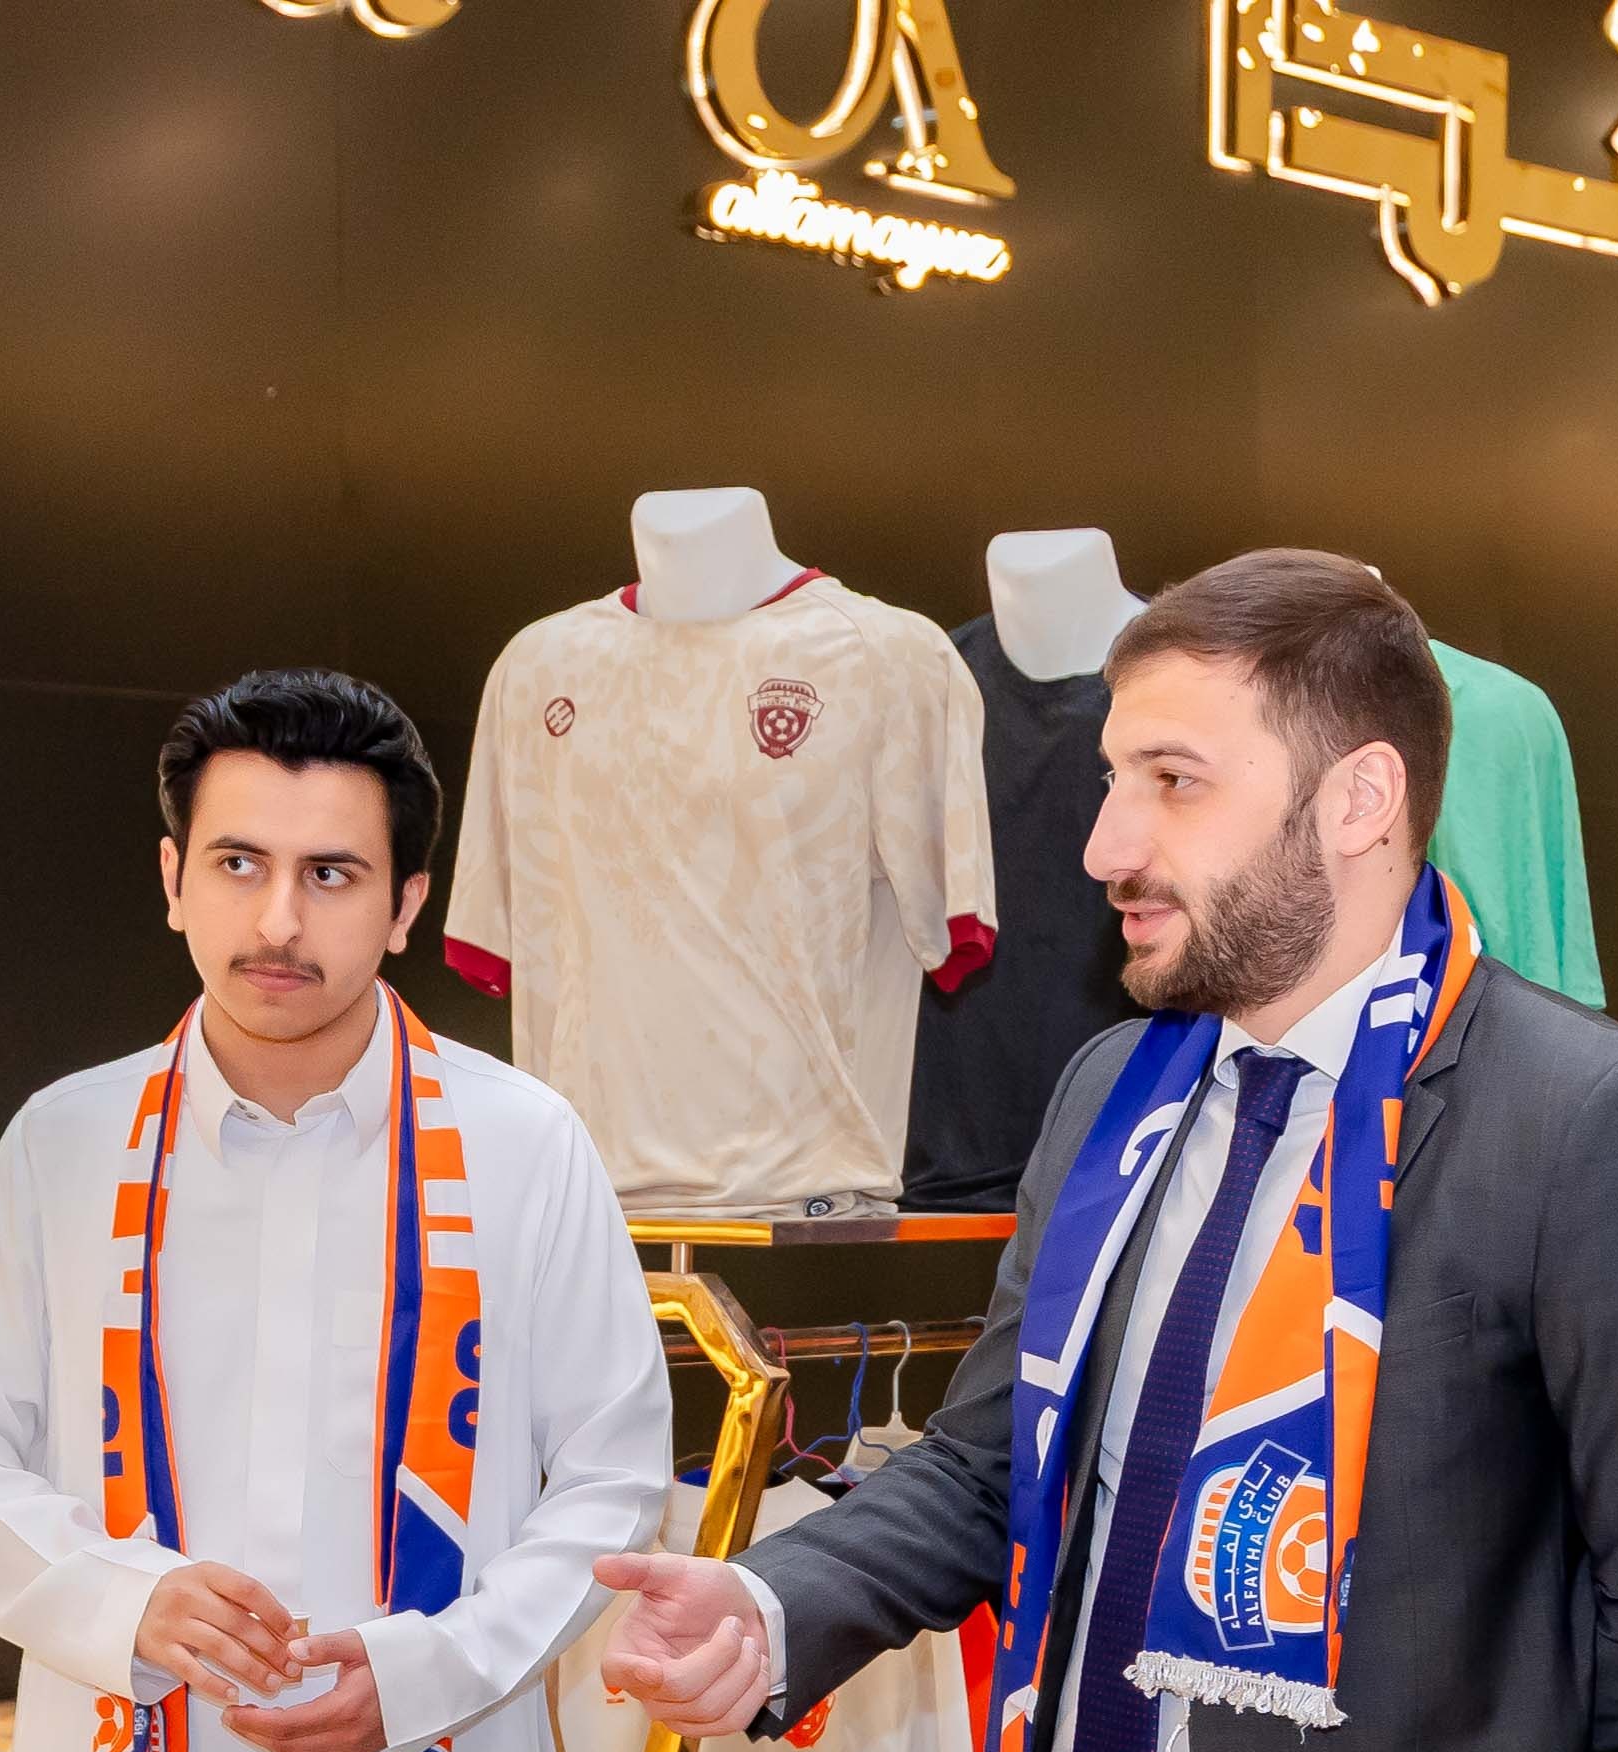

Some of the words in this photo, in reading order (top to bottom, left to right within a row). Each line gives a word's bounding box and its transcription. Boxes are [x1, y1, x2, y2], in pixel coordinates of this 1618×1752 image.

[1238, 1460, 1273, 1520] نادي
[1221, 1521, 1243, 1628] الفيحاء
[1244, 1533, 1265, 1627] ALFAYHA
[1256, 1474, 1292, 1525] CLUB
